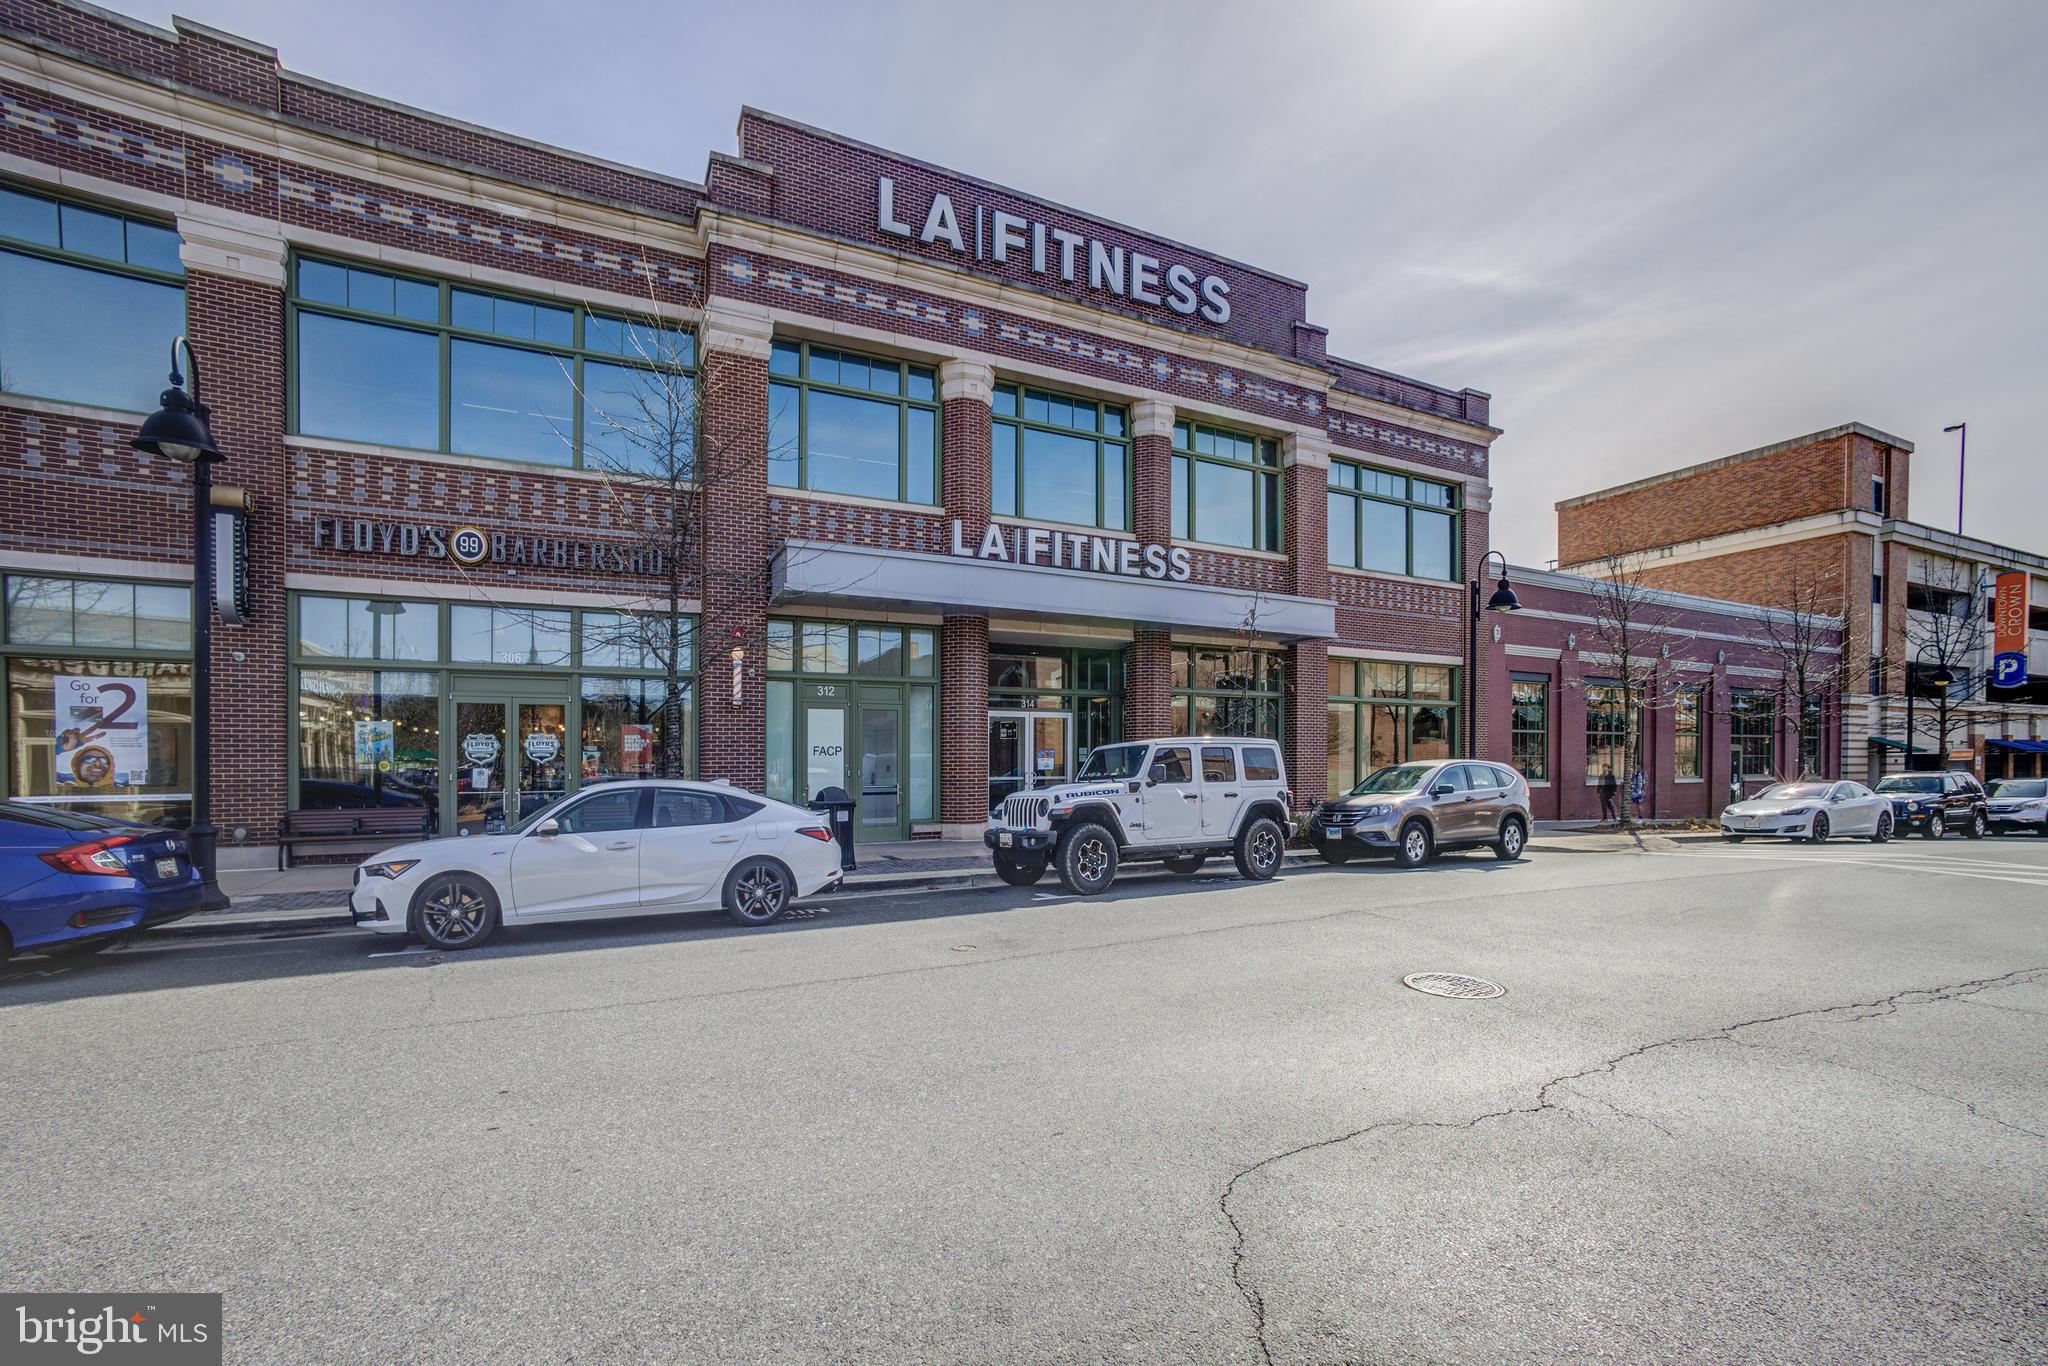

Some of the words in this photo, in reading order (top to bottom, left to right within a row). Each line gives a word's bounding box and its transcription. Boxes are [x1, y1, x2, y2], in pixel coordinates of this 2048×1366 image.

[877, 176, 965, 252] LA
[992, 210, 1232, 324] FITNESS
[314, 516, 447, 559] FLOYD'S
[459, 536, 479, 553] 99
[491, 531, 680, 576] BARBERSHO
[950, 519, 1010, 561] LA
[1026, 528, 1191, 581] FITNESS
[1998, 586, 2007, 637] DOWNTOWN
[2008, 584, 2023, 636] CROWN
[501, 652, 521, 664] 306
[70, 680, 90, 691] Go
[817, 685, 835, 696] 312
[80, 693, 100, 704] for
[97, 682, 138, 729] 2
[1021, 699, 1034, 708] 314
[466, 741, 495, 749] FLOYD'S
[813, 745, 842, 756] FACP
[1065, 788, 1120, 799] RUBICON
